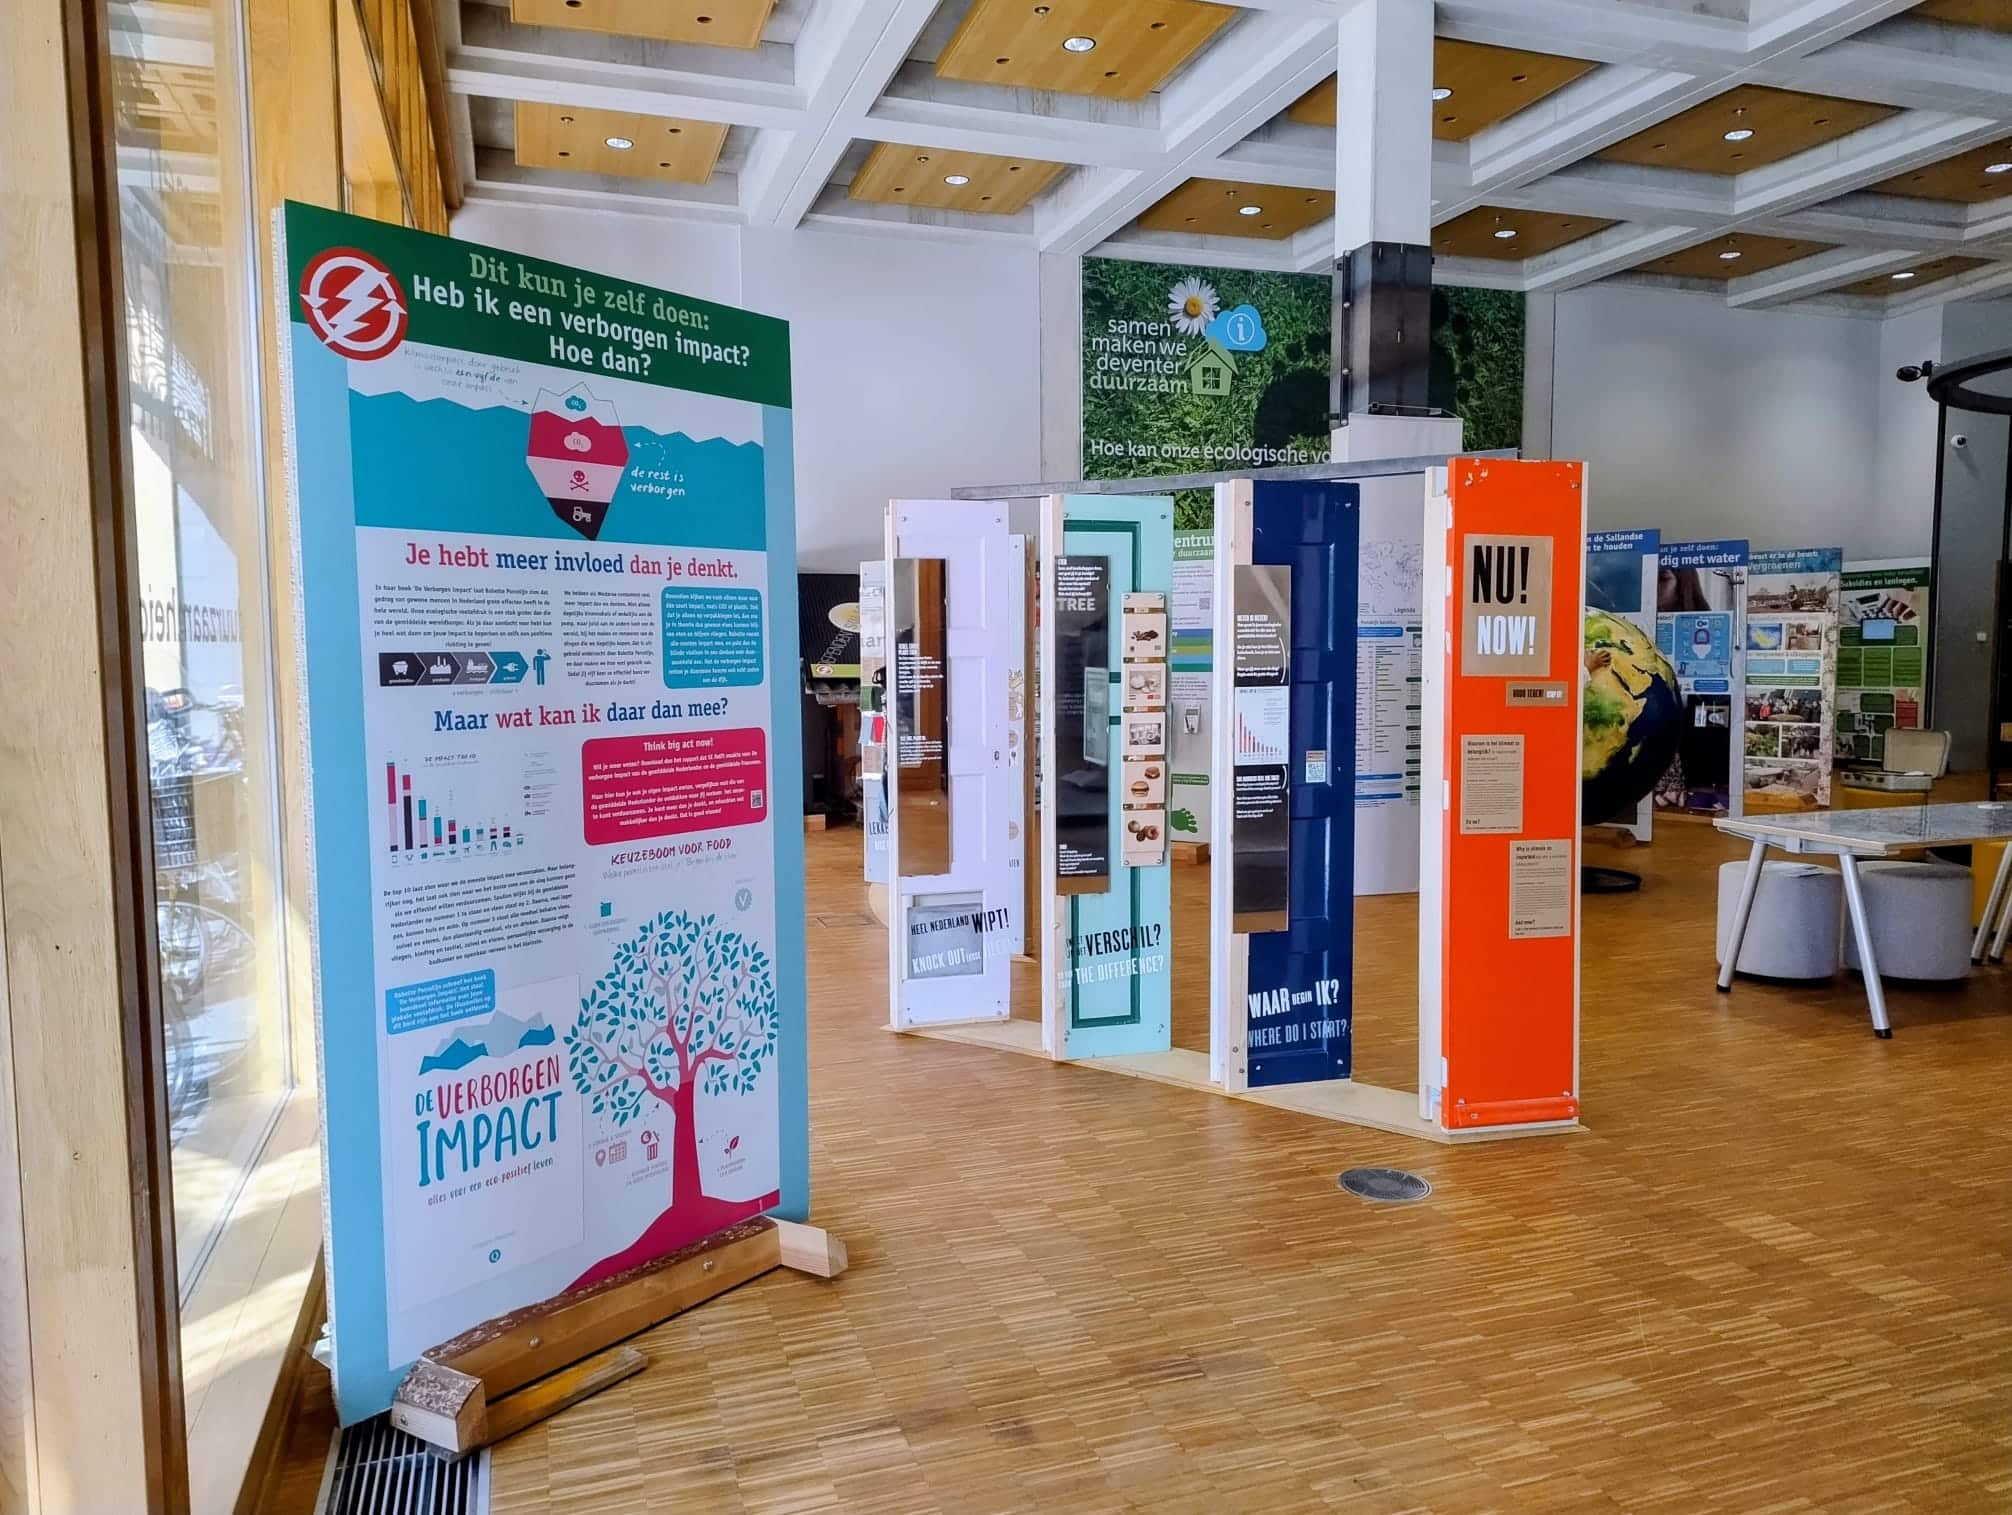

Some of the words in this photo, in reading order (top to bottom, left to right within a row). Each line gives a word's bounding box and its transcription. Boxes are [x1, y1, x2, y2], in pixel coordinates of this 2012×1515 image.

[470, 253, 509, 285] Dit
[518, 264, 566, 298] kun
[574, 277, 596, 306] je
[603, 290, 645, 316] zelf
[652, 299, 711, 330] doen:
[413, 274, 465, 308] Heb
[474, 288, 499, 316] ik
[508, 299, 551, 326] een
[560, 314, 668, 355] verborgen
[675, 332, 749, 367] impact?
[1108, 319, 1171, 337] samen
[550, 336, 594, 367] Hoe
[602, 345, 652, 376] dan?
[1092, 336, 1157, 355] maken
[1159, 342, 1187, 357] we
[1096, 354, 1181, 374] deventer
[1089, 372, 1188, 394] duurzaam
[1091, 440, 1124, 456] Hoe
[1128, 442, 1158, 458] kan
[1161, 445, 1201, 461] onze
[1203, 445, 1302, 466] ecologische
[631, 466, 645, 477] de
[648, 470, 670, 480] rest
[674, 472, 684, 482] is
[630, 483, 686, 500] verborgen
[1604, 542, 1633, 550] houden
[1605, 533, 1643, 542] Sallandse
[406, 542, 430, 565] Je
[438, 546, 489, 568] hebt
[495, 552, 549, 571] meer
[554, 551, 624, 574] invloed
[630, 557, 662, 576] dan
[666, 558, 682, 581] je
[687, 559, 738, 579] denkt.
[1661, 556, 1678, 567] dig
[1682, 555, 1704, 565] met
[1707, 553, 1741, 564] water
[1472, 545, 1530, 604] NU!
[1056, 598, 1096, 611] TREE
[1477, 616, 1536, 655] NOW!
[434, 710, 488, 731] Maar
[496, 708, 533, 728] wat
[539, 705, 576, 725] kan
[582, 704, 601, 723] ik
[607, 702, 646, 722] daar
[652, 701, 683, 719] dan
[688, 698, 728, 716] mee?
[643, 742, 665, 752] Think
[668, 740, 680, 751] big
[682, 739, 693, 748] act
[696, 738, 714, 747] now!
[611, 846, 675, 865] KEUZEBOOM
[679, 843, 702, 856] VOOR
[707, 838, 732, 850] FOOD
[911, 922, 928, 935] HEEL
[930, 915, 969, 931] NEDERLAND
[971, 908, 1010, 934] WIPT!
[1086, 924, 1161, 956] VERSCHIL?
[912, 951, 945, 975] KNOCK
[948, 948, 966, 969] OUT
[1075, 966, 1095, 984] THE
[1098, 955, 1164, 981] DIFFERENCE?
[1248, 988, 1290, 1018] WAAR
[1292, 991, 1312, 1005] BEGIN
[1315, 979, 1339, 1005] IK?
[1248, 1027, 1282, 1048] WHERE
[1285, 1024, 1299, 1042] DO
[1303, 1023, 1306, 1040] I
[1310, 1019, 1347, 1039] START?
[415, 1089, 433, 1116] DE
[437, 1054, 561, 1119] VERBORGEN
[416, 1091, 563, 1188] IMPACT
[501, 1165, 532, 1184] positief
[533, 1157, 554, 1170] leven
